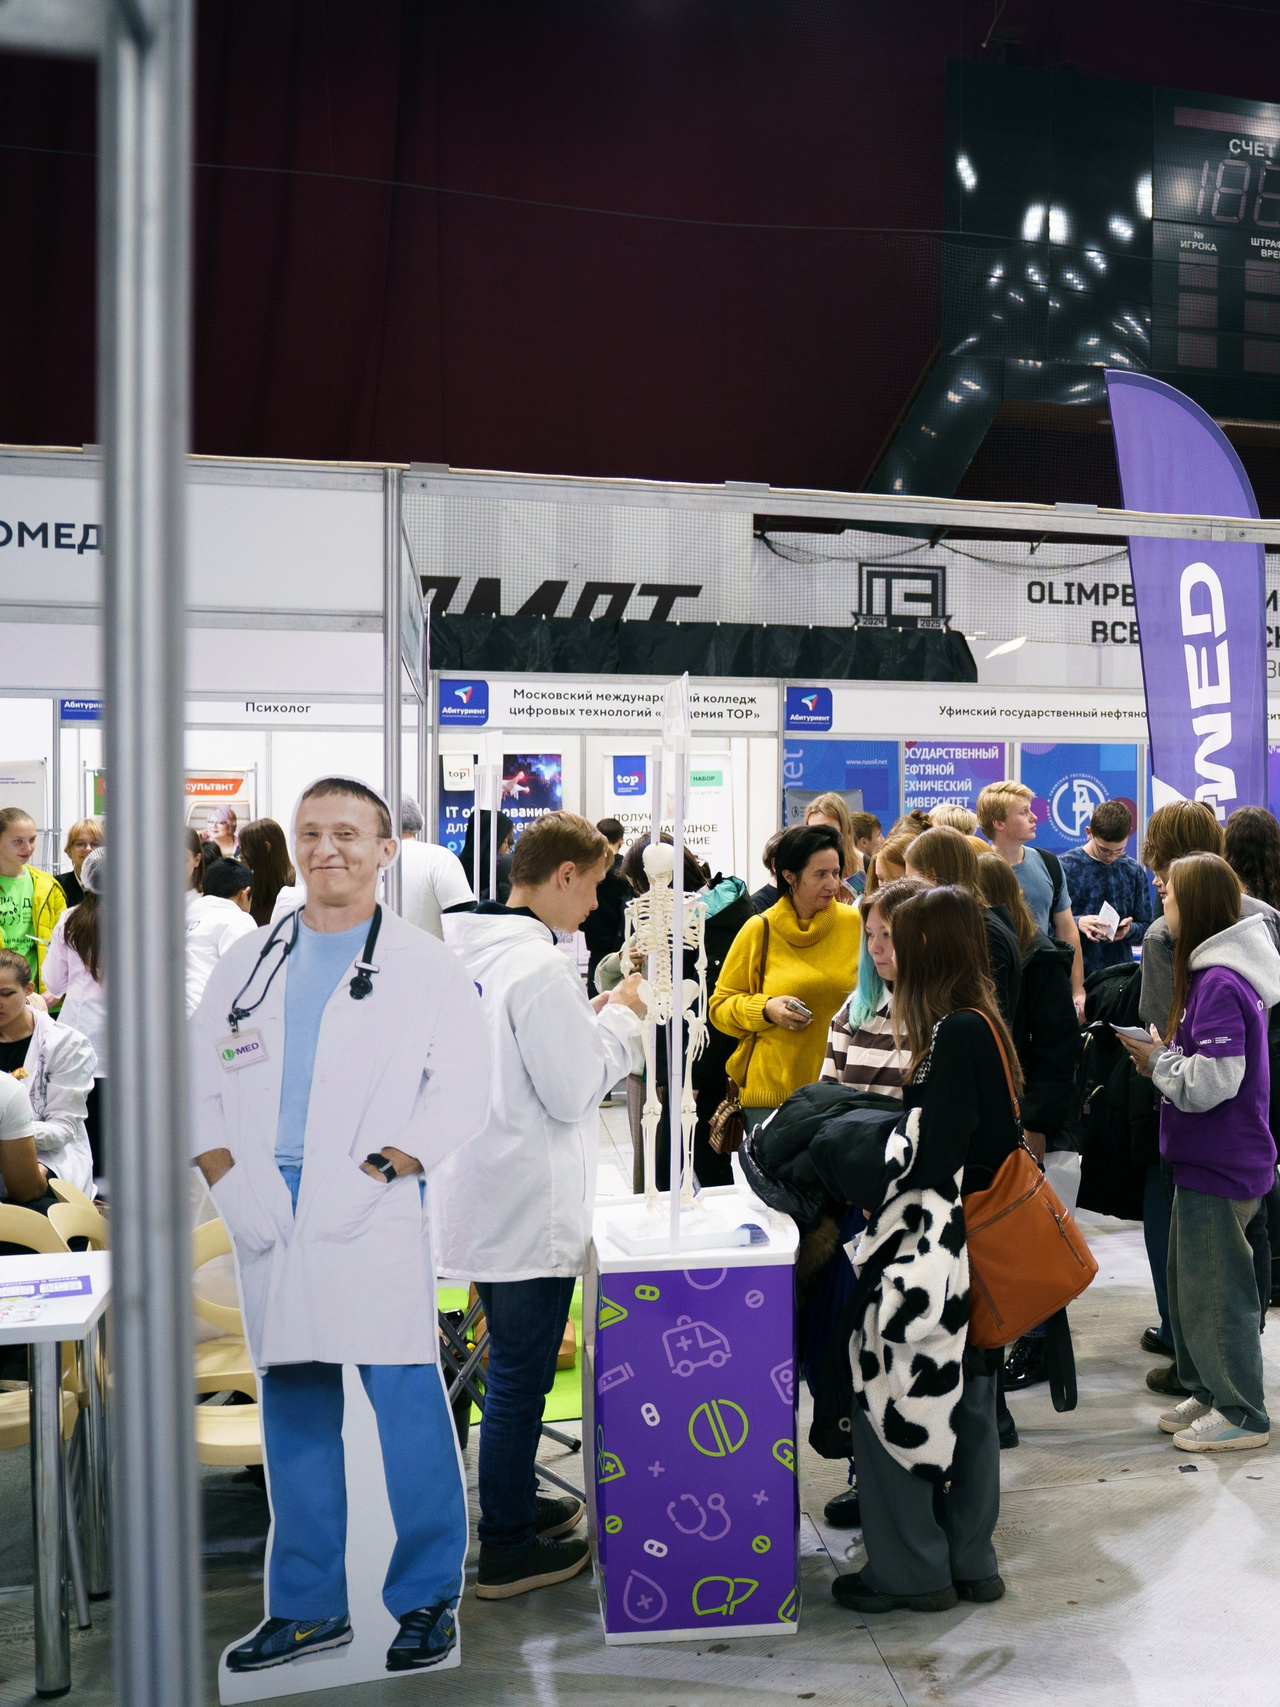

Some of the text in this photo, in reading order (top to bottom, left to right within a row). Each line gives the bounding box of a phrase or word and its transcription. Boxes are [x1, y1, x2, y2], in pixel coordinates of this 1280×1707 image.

[1228, 138, 1277, 158] СЧЕТ
[1180, 240, 1217, 252] ИГРОКА
[862, 617, 884, 627] 2024
[920, 618, 941, 628] 2025
[513, 688, 593, 701] Московский
[703, 695, 757, 705] колледж
[245, 702, 311, 714] Психолог
[442, 706, 486, 716] Абитуриент
[509, 705, 576, 718] цифровых
[578, 707, 652, 718] технологий
[939, 705, 1147, 720] Уфимский государственный нефтяно
[789, 713, 830, 722] Абитуриент
[905, 747, 999, 761] ОСУДАРСТВЕННЫЙ
[846, 758, 888, 766] www.rusoil.net
[448, 770, 467, 779] top
[905, 764, 954, 776] ЕФТЯНОЙ
[617, 774, 639, 786] top
[905, 779, 972, 792] ЕХНИЧЕСКИЙ
[905, 796, 969, 809] НИВЕРСИТЕТ
